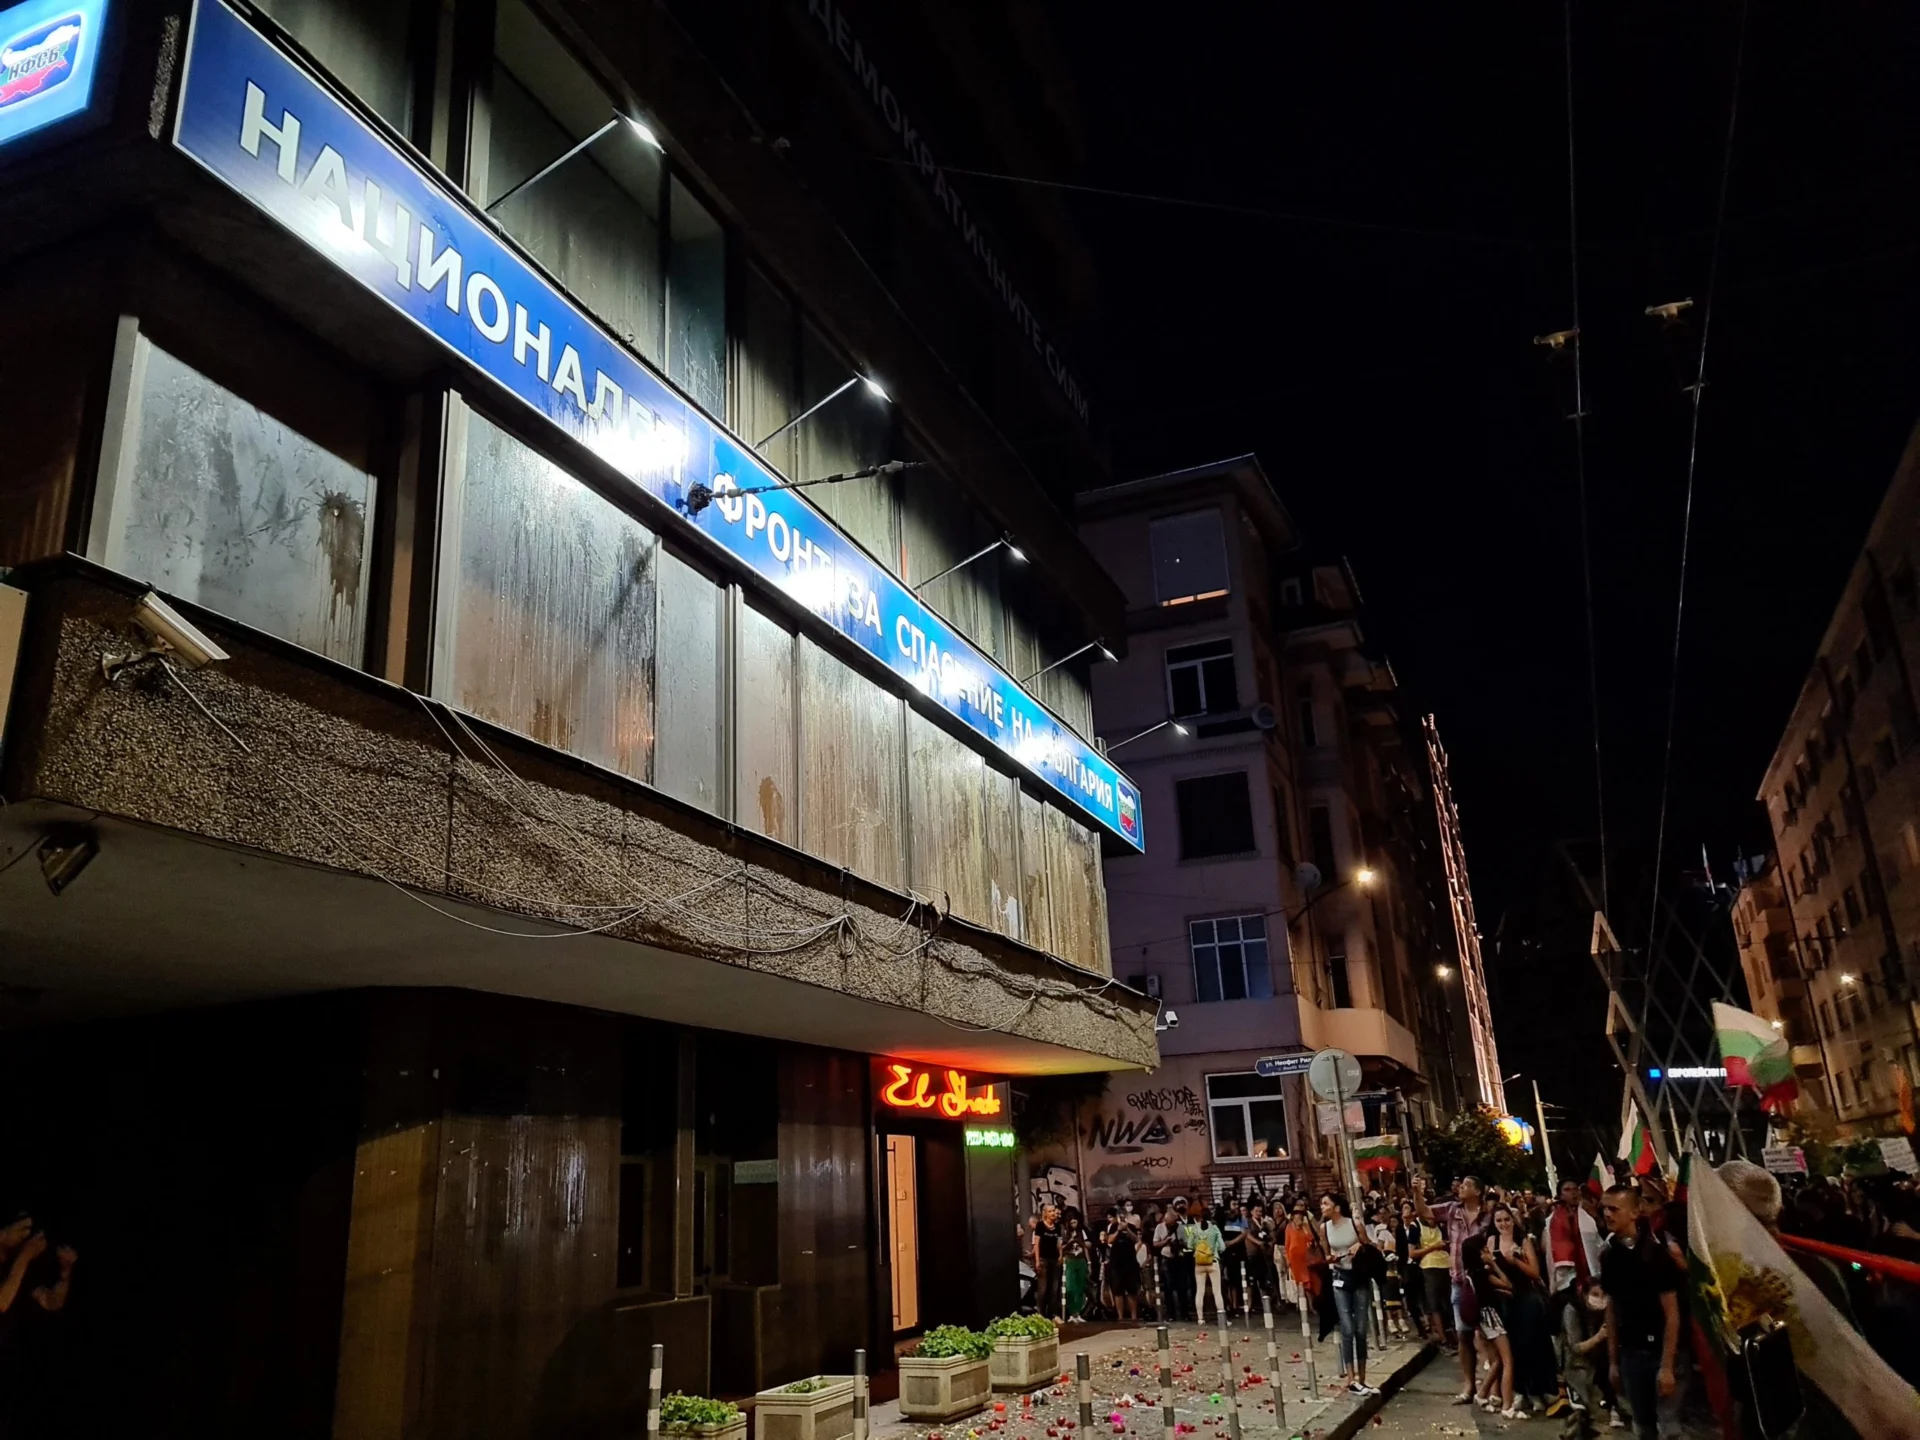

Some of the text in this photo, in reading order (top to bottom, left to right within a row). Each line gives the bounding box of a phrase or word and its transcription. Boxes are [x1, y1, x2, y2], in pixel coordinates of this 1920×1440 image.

[8, 47, 60, 81] НФСБ
[239, 78, 682, 487] НАЦИОНАЛЕ
[845, 572, 884, 637] ЗА
[882, 1064, 937, 1109] El
